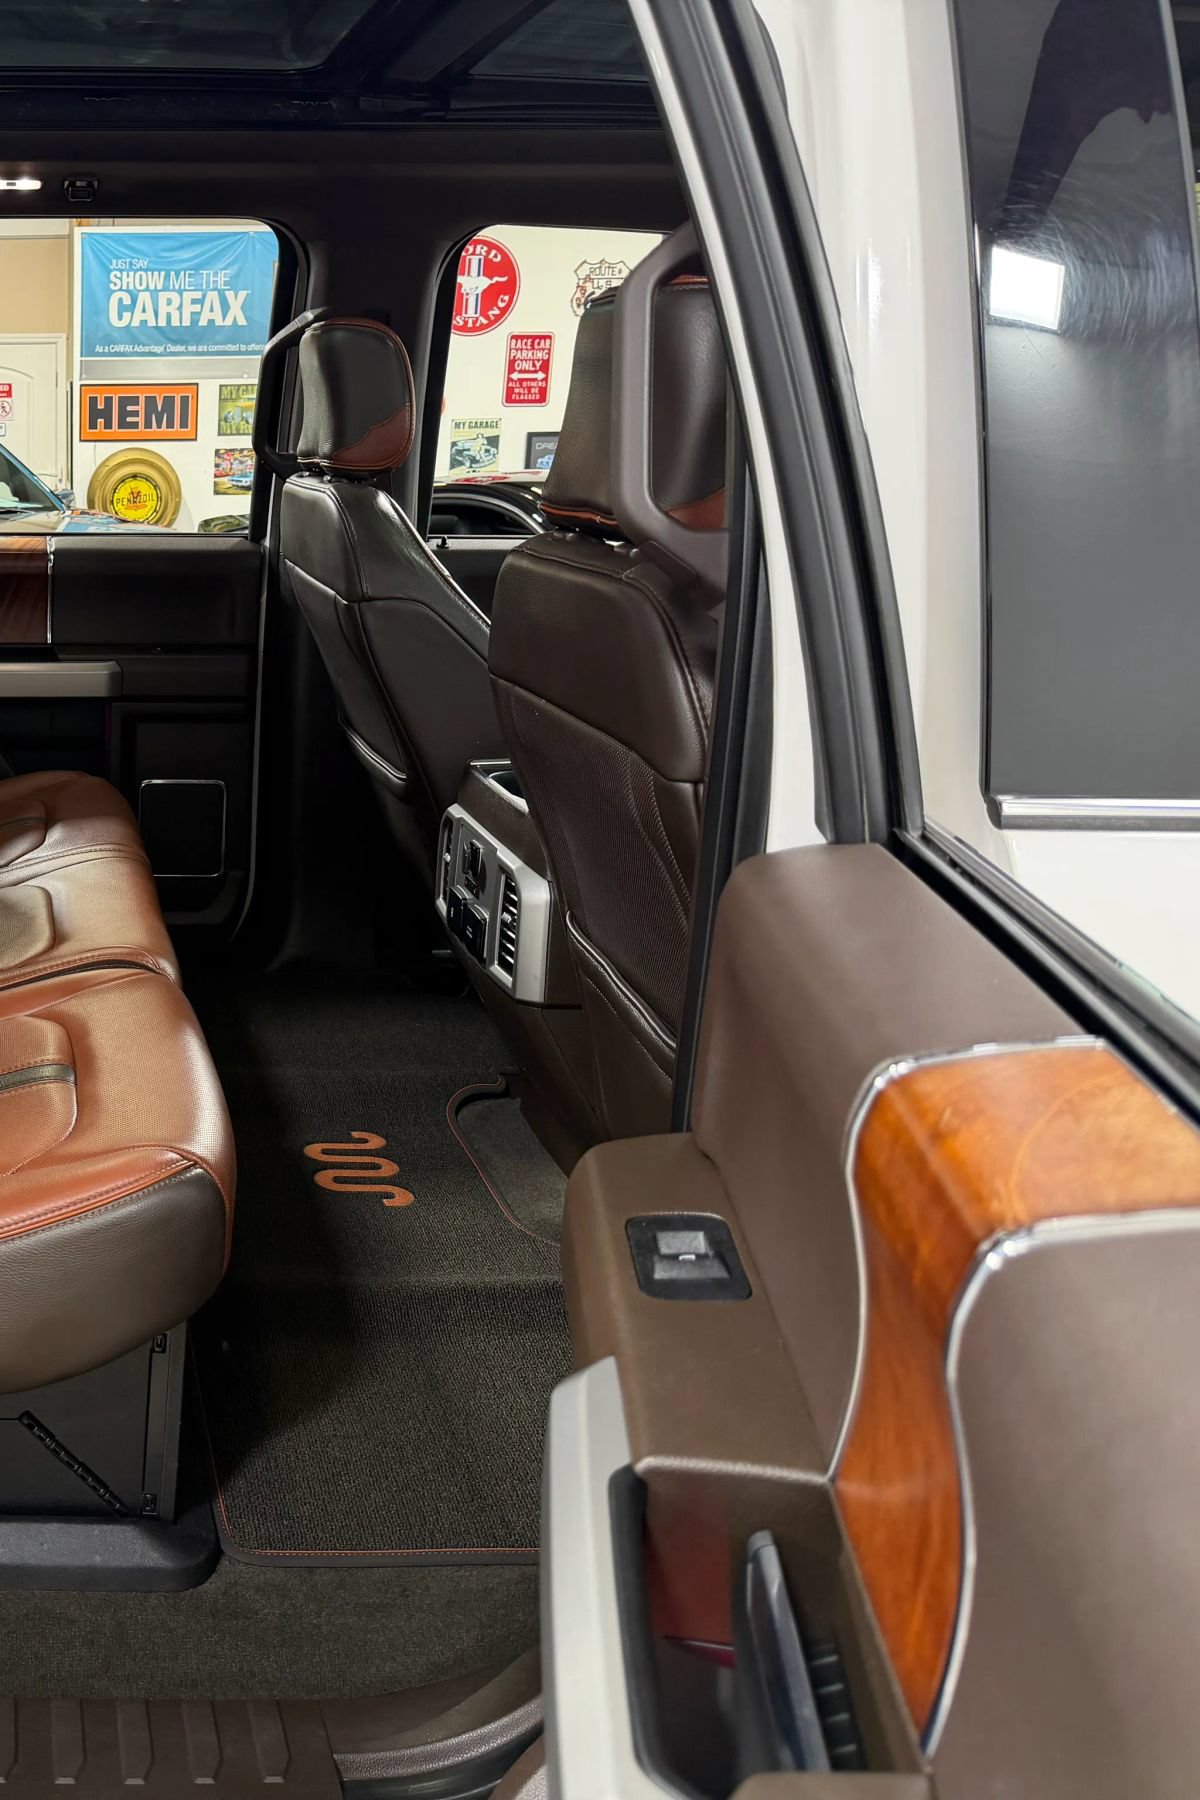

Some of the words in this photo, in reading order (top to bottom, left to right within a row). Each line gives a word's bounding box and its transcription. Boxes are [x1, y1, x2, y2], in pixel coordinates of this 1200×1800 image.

[461, 244, 502, 263] ORD
[109, 258, 131, 269] JUST
[132, 258, 149, 269] SAY
[589, 266, 617, 277] ROUTE
[109, 271, 165, 290] SHOW
[169, 271, 195, 289] ME
[201, 271, 230, 289] THE
[108, 290, 248, 328] CARFAX
[453, 294, 510, 328] STANG
[95, 344, 103, 353] As
[109, 344, 133, 352] CARFAX
[208, 343, 239, 352] committed
[240, 343, 246, 351] to
[510, 338, 532, 349] RACE
[533, 338, 551, 349] CAR
[510, 349, 549, 360] PARKING
[514, 360, 543, 371] ONLY
[222, 386, 237, 399] MY
[86, 393, 192, 432] HEMI
[454, 421, 466, 430] MY
[468, 420, 500, 430] GARAGE
